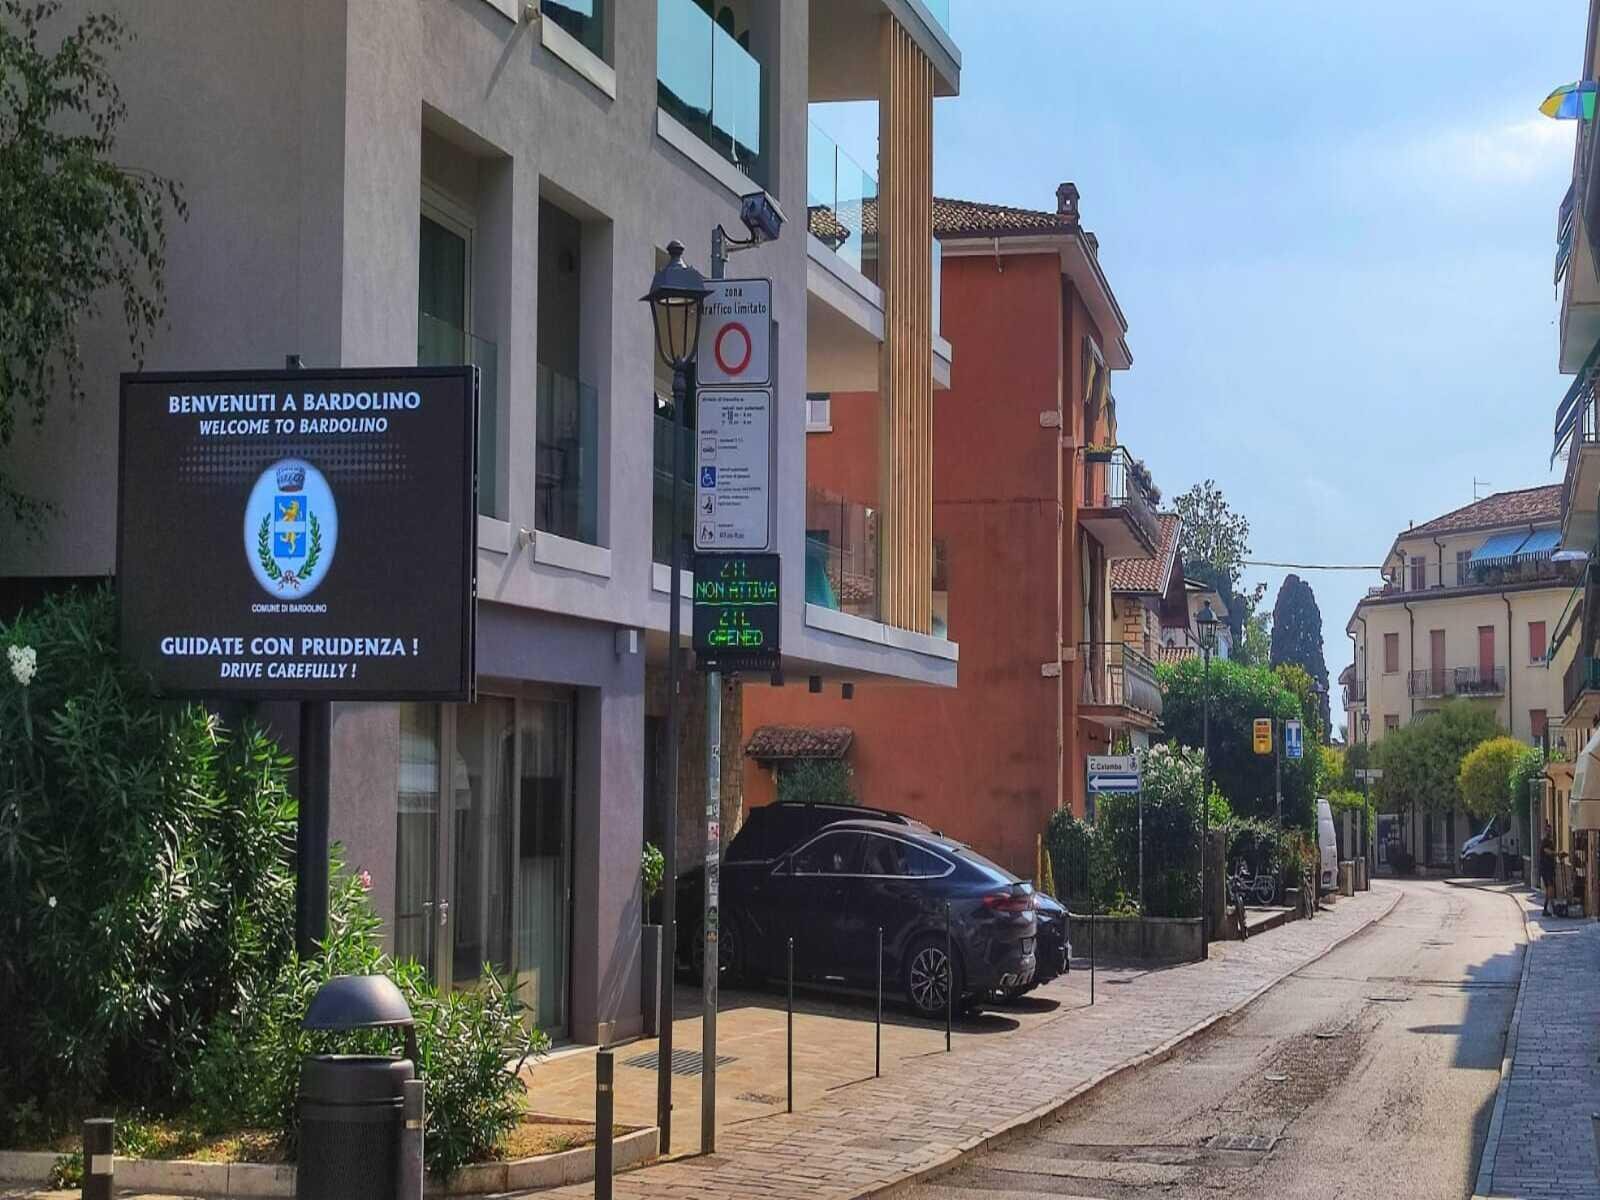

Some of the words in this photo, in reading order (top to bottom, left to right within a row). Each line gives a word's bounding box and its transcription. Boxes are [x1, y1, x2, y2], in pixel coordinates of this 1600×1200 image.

[725, 287, 743, 297] zona
[734, 301, 767, 314] limitato
[168, 394, 276, 414] BENVENUTI
[282, 393, 297, 411] A
[303, 391, 421, 411] BARDOLINO
[200, 419, 270, 435] WELCOME
[275, 418, 295, 434] TO
[300, 417, 388, 434] BARDOLINO
[695, 581, 725, 599] NON
[729, 581, 777, 599] ATTIVA
[251, 604, 280, 613] COMUNE
[281, 604, 289, 613] DI
[289, 604, 328, 613] BARDOLINO
[160, 637, 244, 655] GUIDATE
[250, 637, 294, 655] CON
[301, 637, 407, 656] PRUDENZA
[220, 662, 264, 678] DRIVE
[267, 662, 348, 678] CAREFULLY
